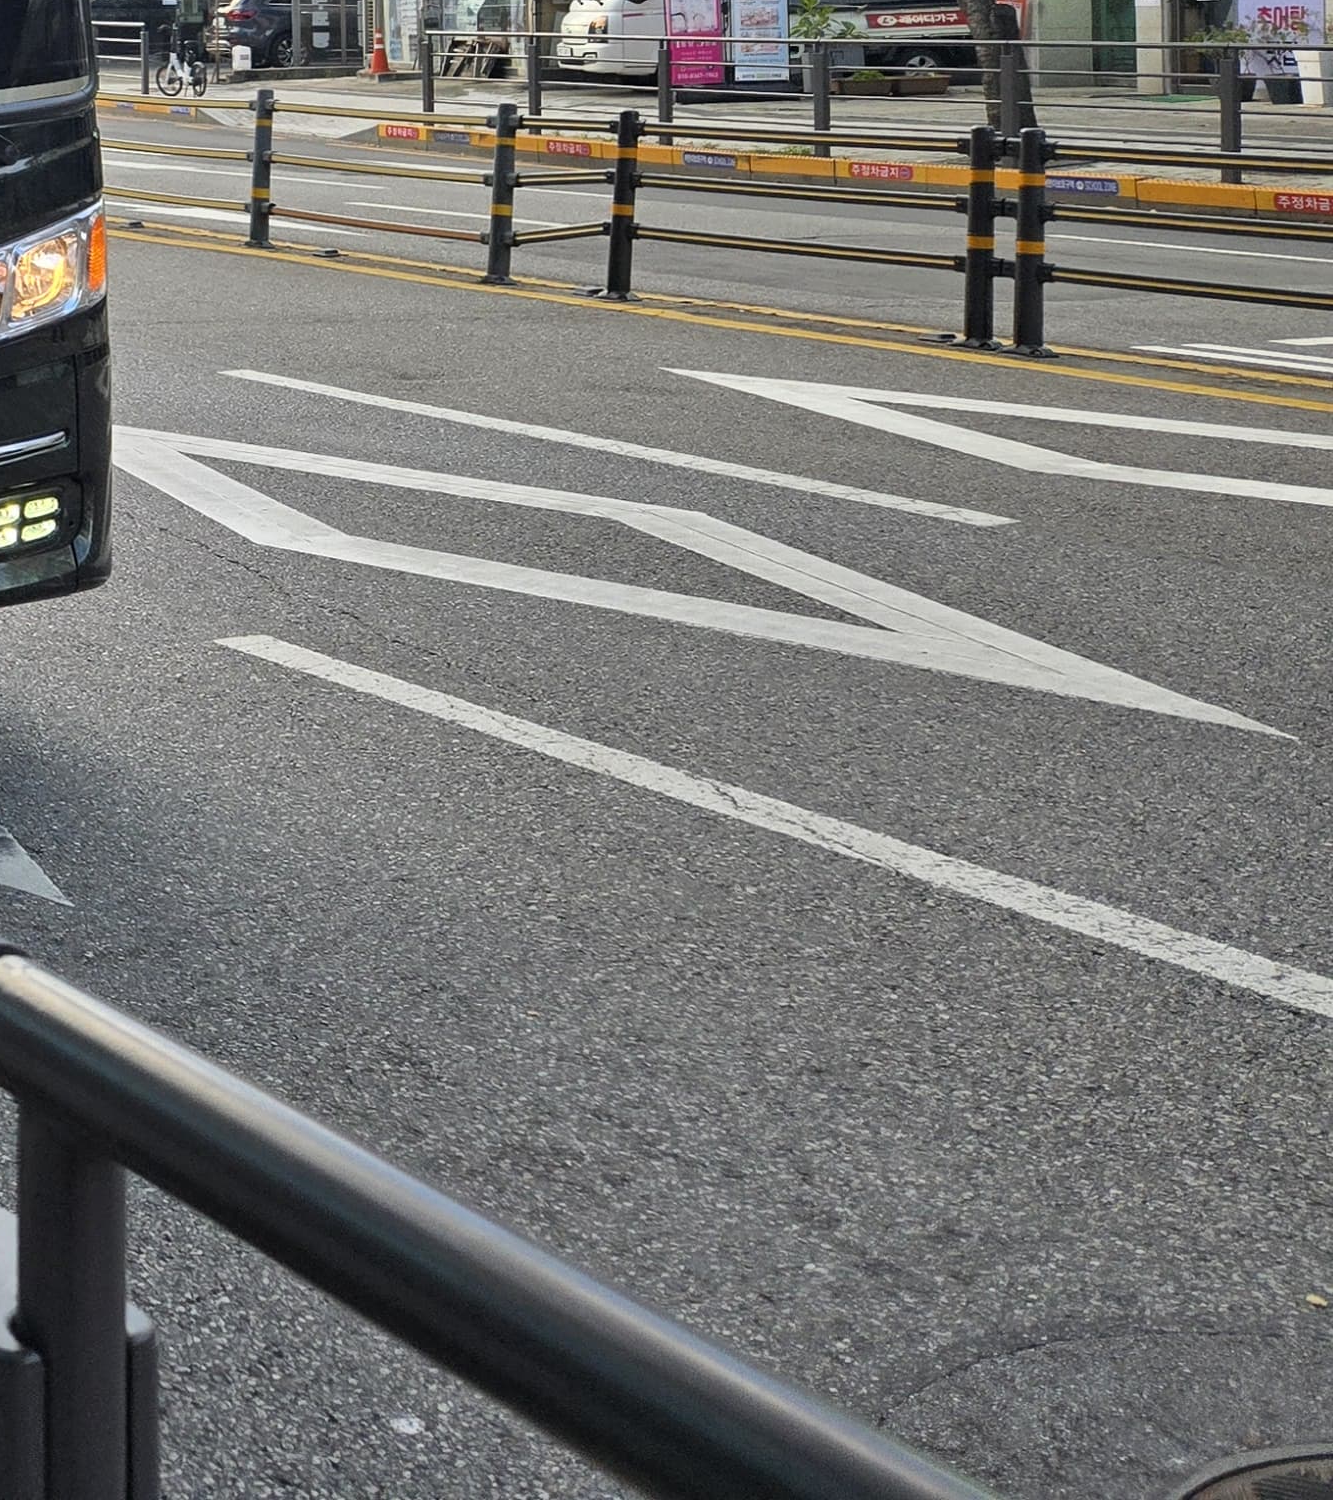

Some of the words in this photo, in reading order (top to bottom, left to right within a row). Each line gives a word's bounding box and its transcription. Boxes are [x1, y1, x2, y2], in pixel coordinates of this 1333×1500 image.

[1257, 6, 1307, 30] 추어탕
[852, 164, 899, 179] 주정차금지
[1277, 195, 1333, 212] 주정차금
